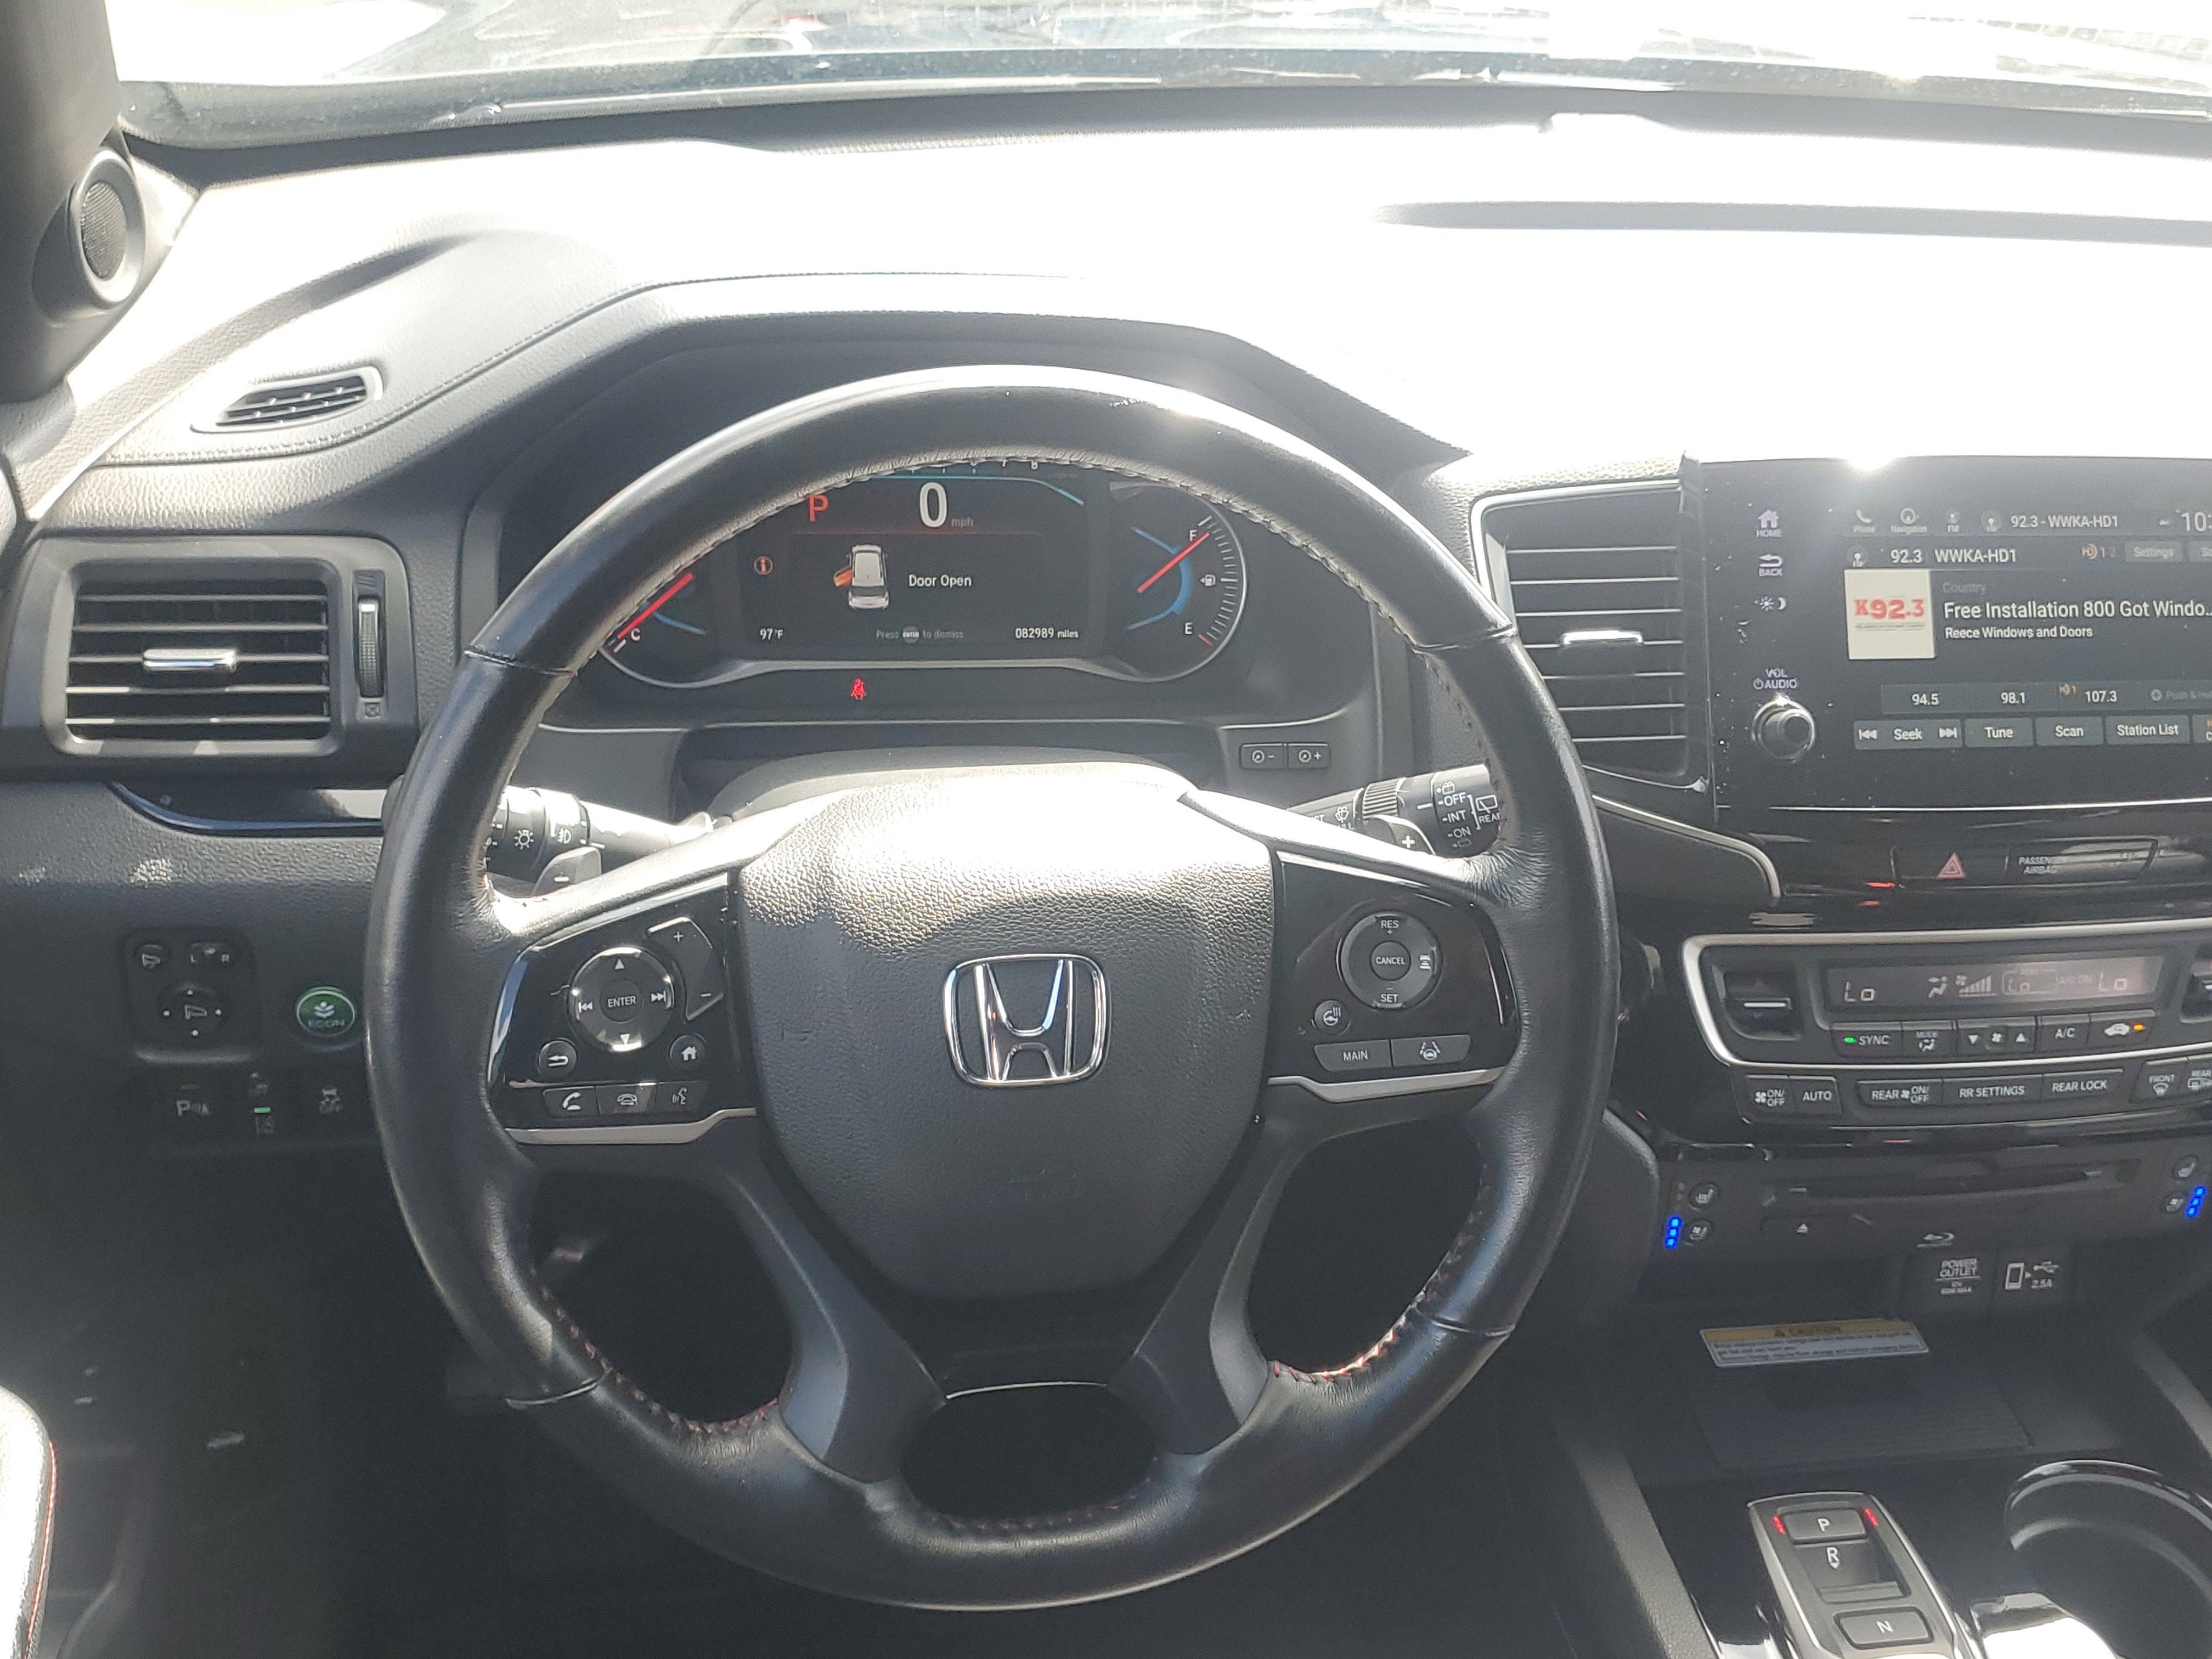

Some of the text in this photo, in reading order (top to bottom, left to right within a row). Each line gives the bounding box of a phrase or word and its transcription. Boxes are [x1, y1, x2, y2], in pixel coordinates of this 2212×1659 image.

[808, 494, 829, 522] P
[919, 482, 973, 527] 0 mph
[2011, 515, 2039, 528] 92.3
[2048, 515, 2118, 528] WWKA-HD1
[1189, 530, 1197, 542] F
[1891, 549, 2017, 564] 92.3 WWKA-HD1
[2134, 547, 2174, 560] Settings
[1759, 568, 1783, 577] BACK
[909, 574, 972, 589] Door Open
[1943, 582, 1987, 595] Country
[1854, 599, 1925, 620] K92.3
[1944, 602, 1982, 619] Free
[1985, 601, 2079, 619] Installation
[2083, 600, 2115, 618] 800
[2119, 600, 2149, 617] Got
[631, 628, 641, 641] C
[923, 630, 932, 639] to
[934, 630, 964, 639] dismiss
[1015, 628, 1079, 640] 082989 miles
[1184, 622, 1193, 635] E
[1945, 626, 2094, 639] Reece Windows and Doors
[1765, 668, 1787, 679] VOL
[1764, 679, 1798, 690] AUDIO
[1911, 693, 1939, 706] 94.5
[2000, 692, 2025, 704] 98.1
[2085, 690, 2118, 703] 107.3
[1893, 727, 1923, 741] Seek
[1984, 726, 2013, 738] Tune
[2055, 725, 2084, 737] Scan
[2117, 723, 2179, 736] Station List
[1443, 792, 1467, 807] OFF
[1447, 809, 1467, 823] INT
[1453, 826, 1472, 839] ON
[1380, 919, 1400, 929] RES
[1375, 956, 1406, 966] CANCEL
[607, 995, 636, 1008] ENTER
[1380, 993, 1398, 1003] SET
[308, 1019, 345, 1028] ECON
[1859, 1035, 1891, 1046] SYNC
[2055, 1028, 2075, 1040] A/C
[1342, 1049, 1368, 1062] MAIN
[2149, 1074, 2176, 1084] FRONT
[2191, 1069, 2212, 1078] REAR
[1959, 1085, 2024, 1098] RR SETTINGS
[2052, 1080, 2107, 1092] REAR LOCK
[1803, 1090, 1832, 1102] AUTO
[1872, 1090, 1899, 1100] REAR
[1910, 1094, 1929, 1104] OFF
[1768, 1098, 1785, 1107] OFF
[1941, 1258, 1977, 1269] POWER
[1939, 1267, 1977, 1277] OUTLET
[1817, 1518, 1830, 1532] P
[1826, 1547, 1840, 1562] R
[1876, 1620, 1893, 1634] N
